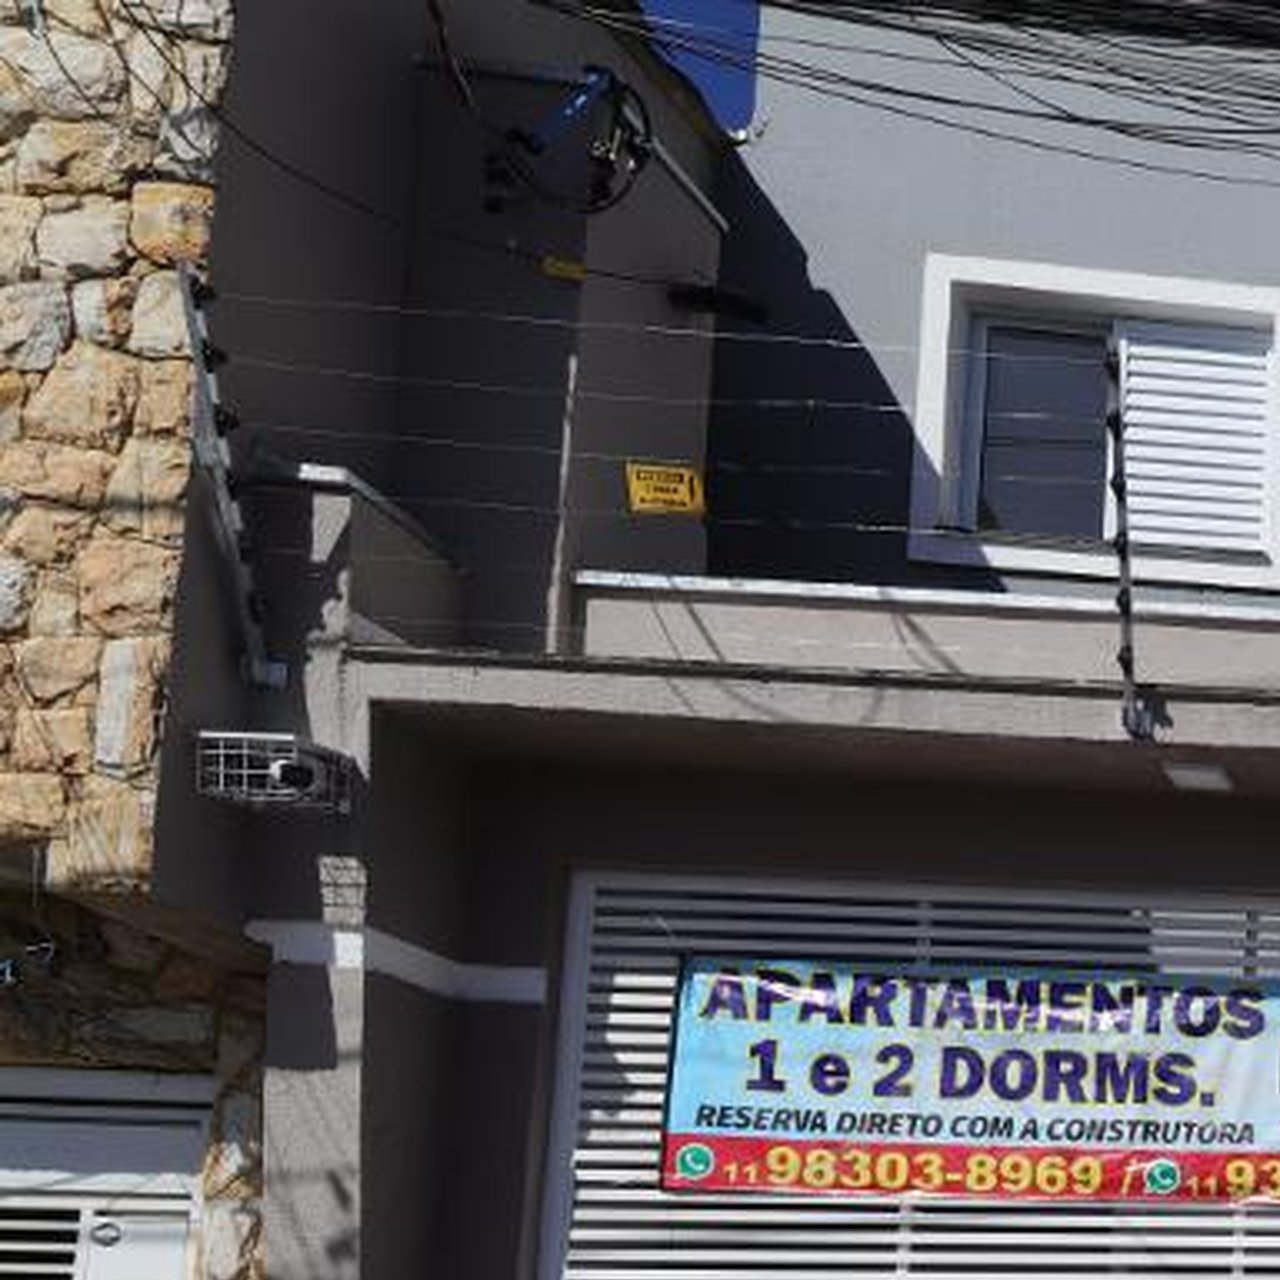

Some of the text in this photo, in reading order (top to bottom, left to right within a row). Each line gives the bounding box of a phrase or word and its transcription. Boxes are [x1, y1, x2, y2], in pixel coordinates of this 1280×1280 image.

[701, 967, 1267, 1039] APARTAMENTOS
[745, 1038, 1215, 1107] 1 e 2 DORMS.
[695, 1104, 1256, 1145] RESERVA DIRETO COM A CONSTRUTORA
[723, 1160, 758, 1186] 11
[765, 1144, 1102, 1194] 98303-8969
[1186, 1175, 1219, 1198] 11
